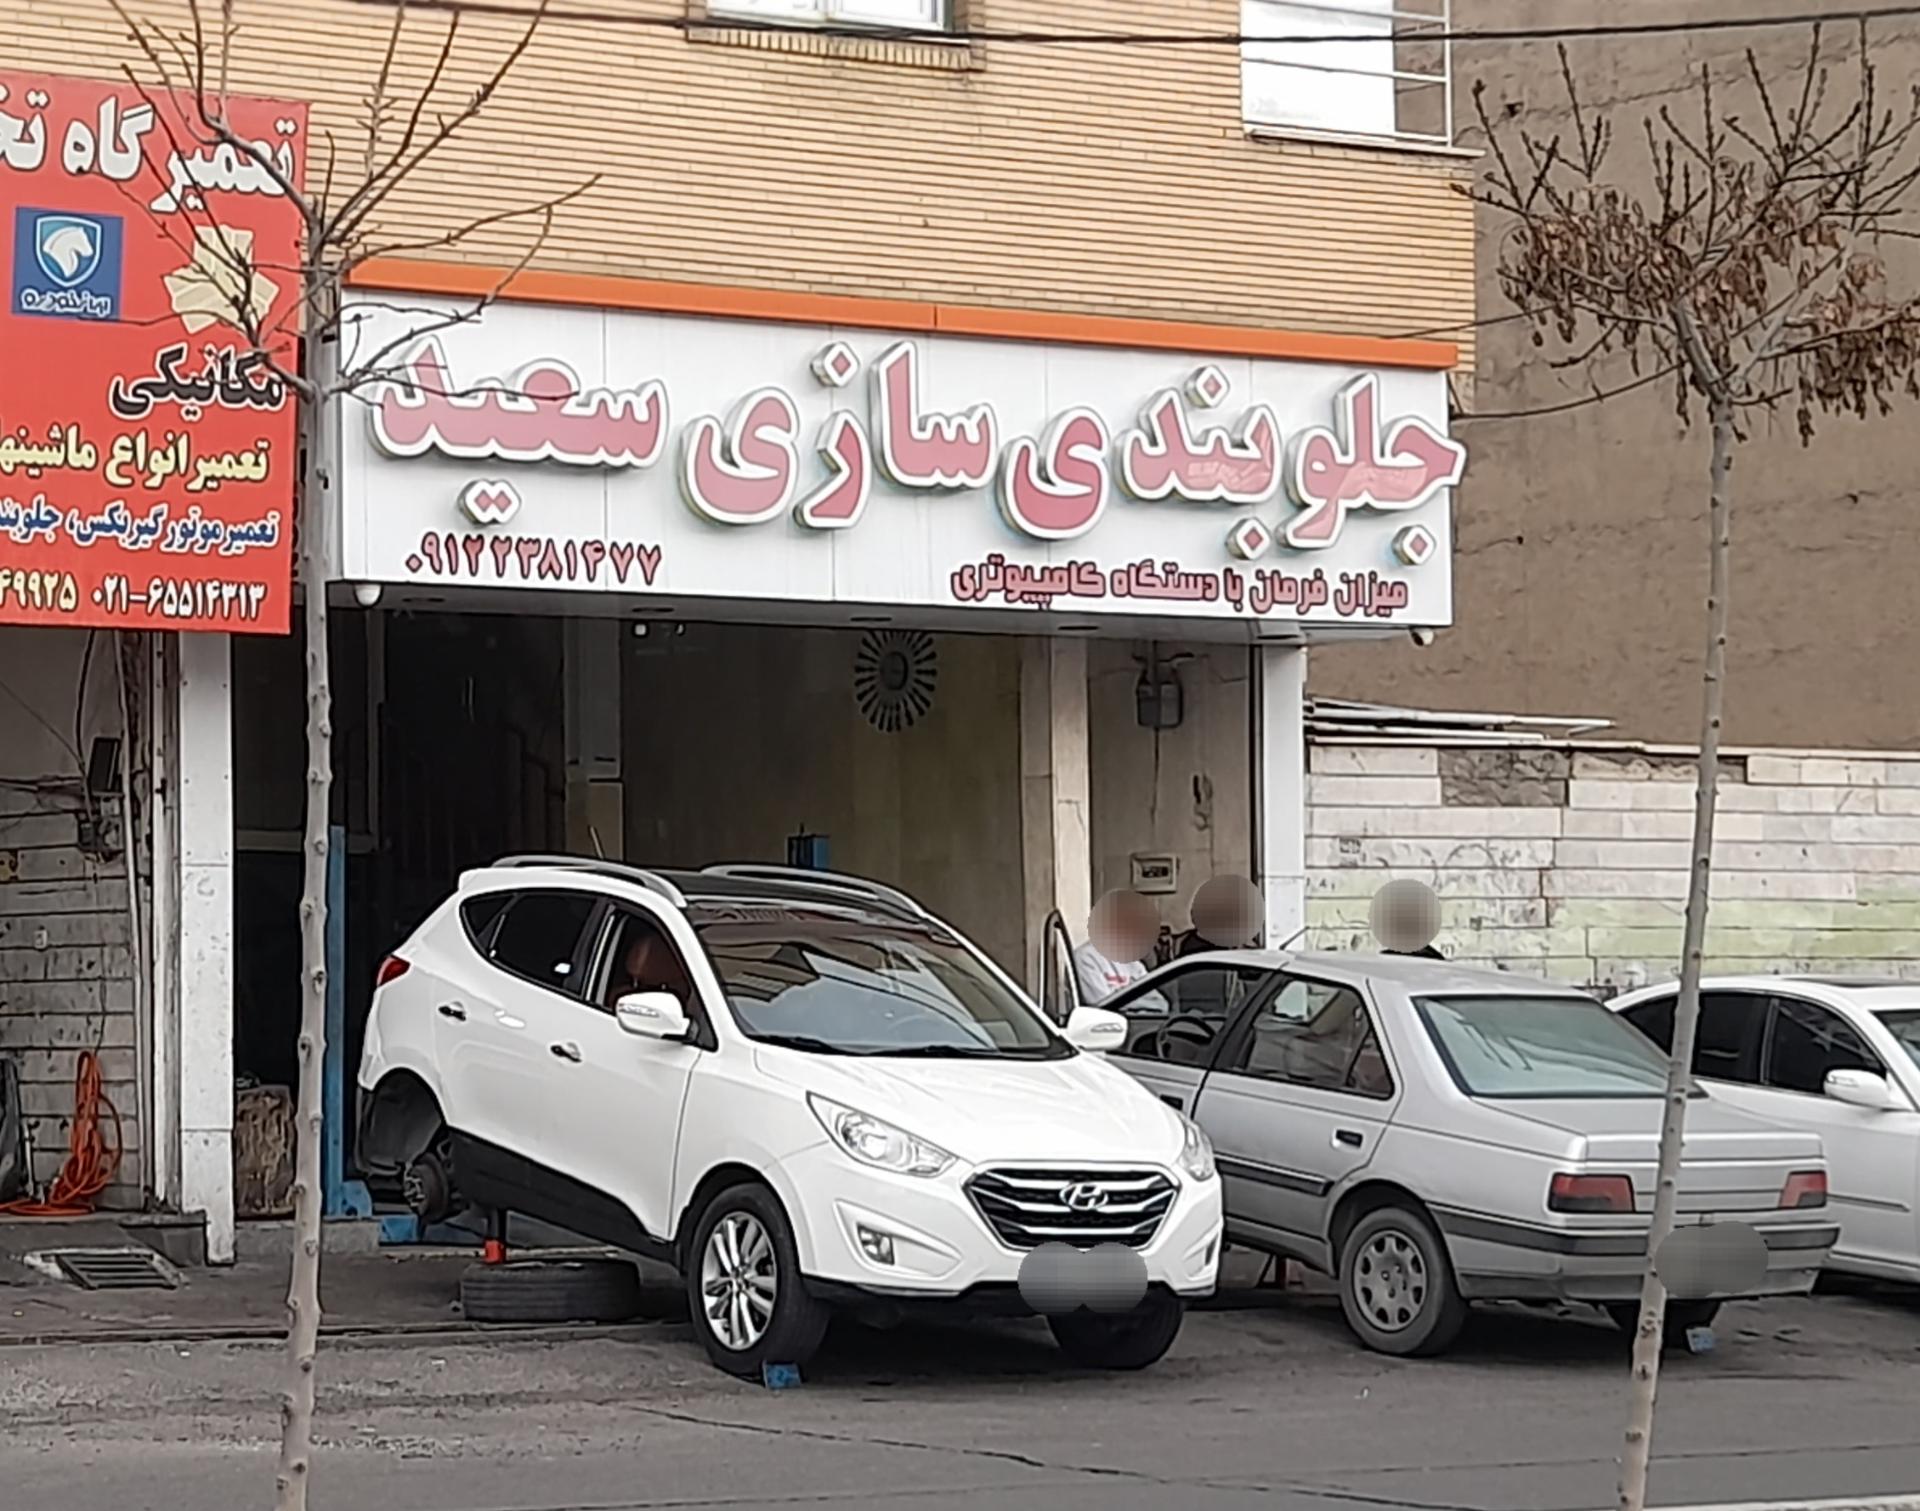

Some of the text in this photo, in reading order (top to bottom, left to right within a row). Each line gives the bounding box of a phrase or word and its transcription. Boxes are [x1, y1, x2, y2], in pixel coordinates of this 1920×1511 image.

[109, 341, 286, 419] مکانیکی
[105, 428, 189, 489] انواع
[369, 334, 669, 525] سعید
[185, 437, 271, 491] تعمیر
[160, 505, 225, 553] موتور
[219, 508, 280, 555] تعمیر
[405, 531, 662, 586] ۰۹۱۲۲۳۸۱۴۷۷
[950, 552, 1408, 617] میزان فرمان با دستگاه کامپیوتری
